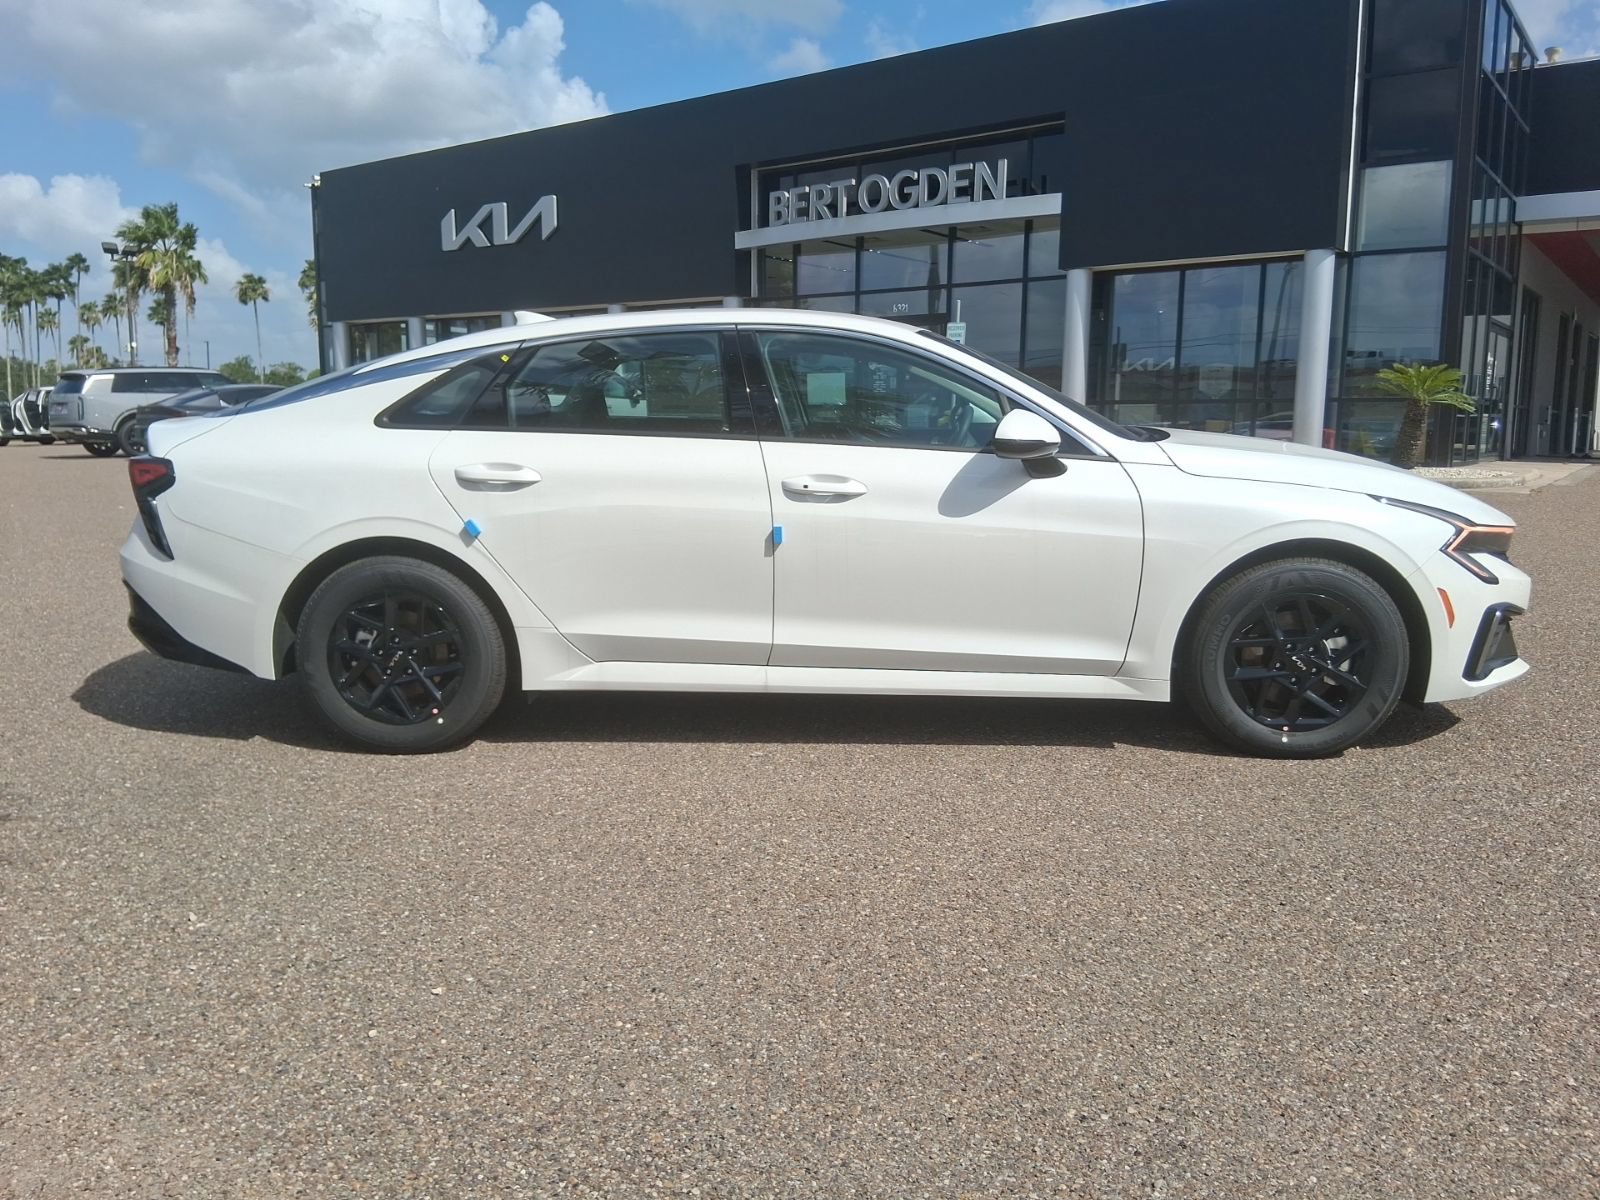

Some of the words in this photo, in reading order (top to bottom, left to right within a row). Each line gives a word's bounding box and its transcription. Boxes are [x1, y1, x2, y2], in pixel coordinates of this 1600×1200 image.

[440, 194, 557, 251] KIA
[769, 178, 856, 227] BERT
[858, 158, 1008, 214] OGDEN
